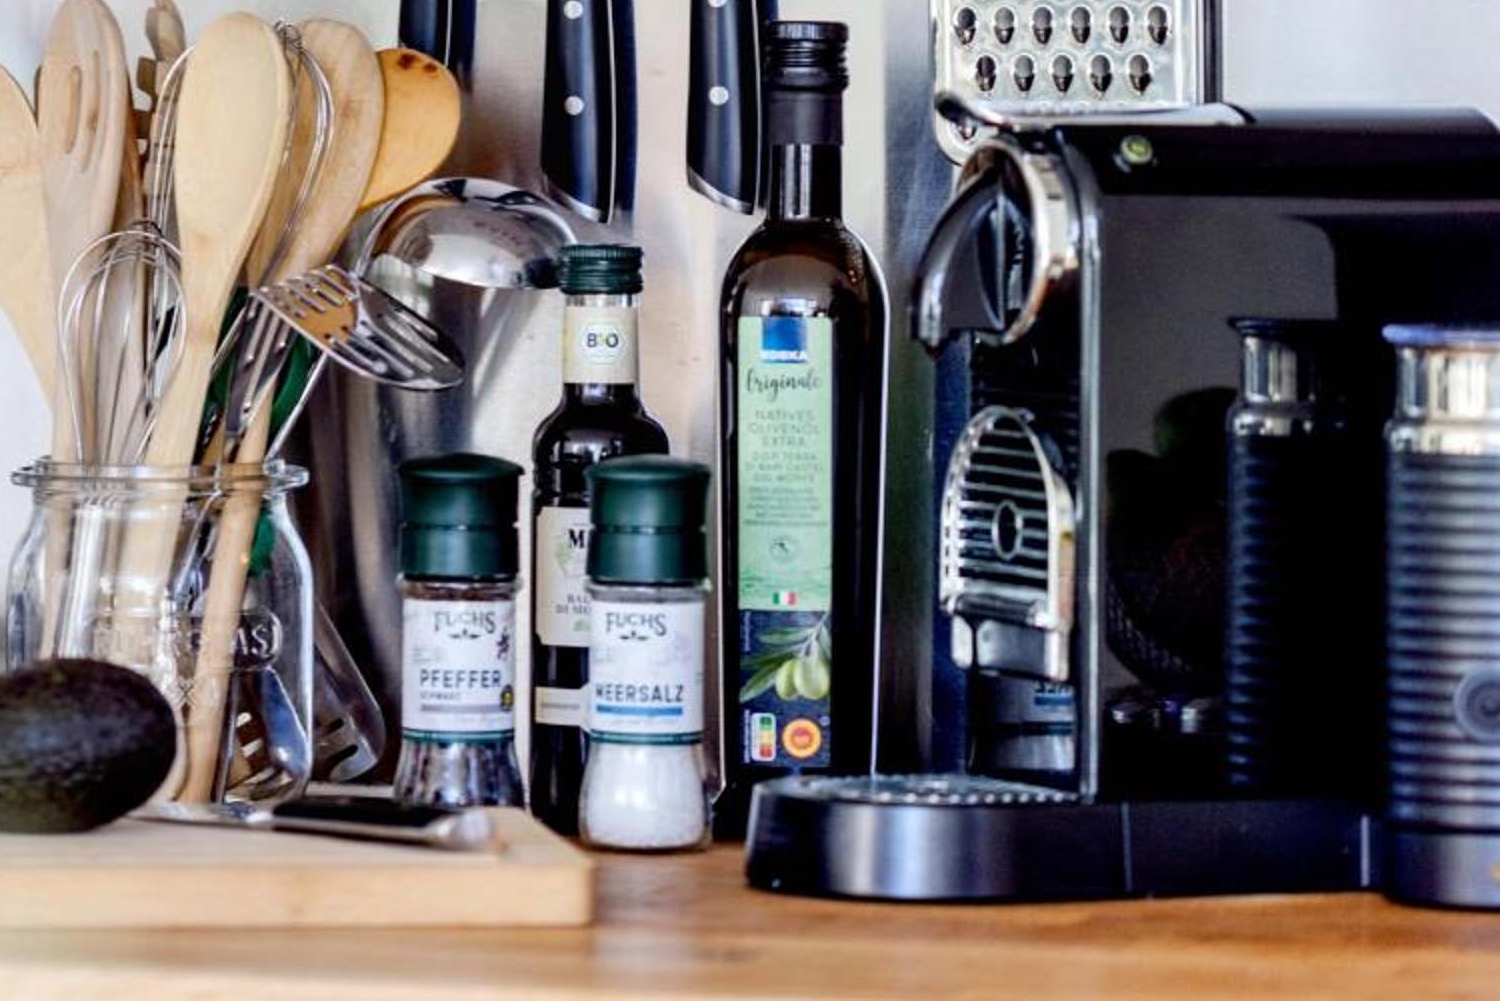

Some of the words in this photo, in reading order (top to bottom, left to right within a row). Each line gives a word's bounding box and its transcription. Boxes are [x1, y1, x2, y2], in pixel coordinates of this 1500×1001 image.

[434, 611, 496, 634] FUCHS
[605, 612, 667, 637] FUCHS
[420, 669, 501, 688] PFEFFER
